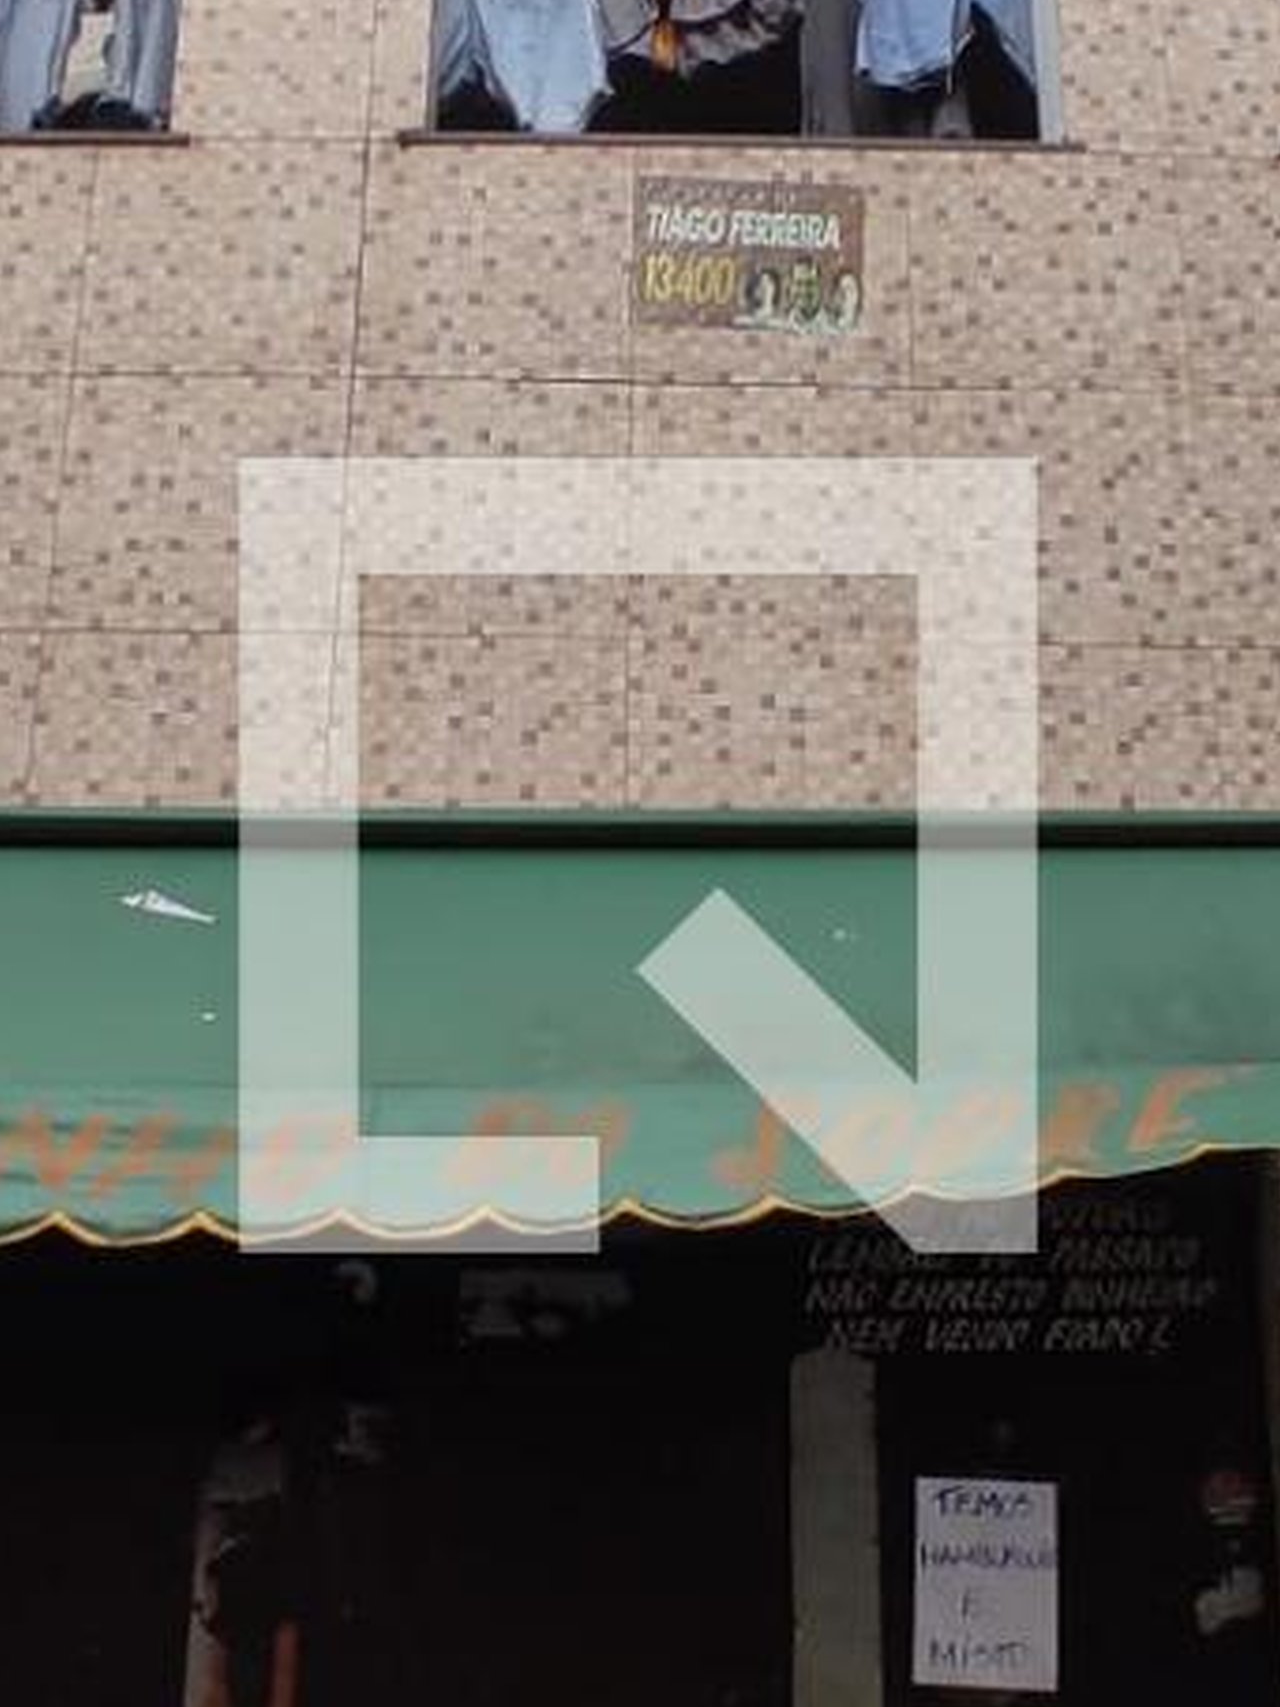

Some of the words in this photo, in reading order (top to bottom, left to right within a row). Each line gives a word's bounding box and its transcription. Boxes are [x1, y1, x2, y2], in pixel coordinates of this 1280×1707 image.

[646, 205, 725, 243] TIAGO
[728, 209, 840, 249] FERREIRA
[642, 251, 735, 304] 13400
